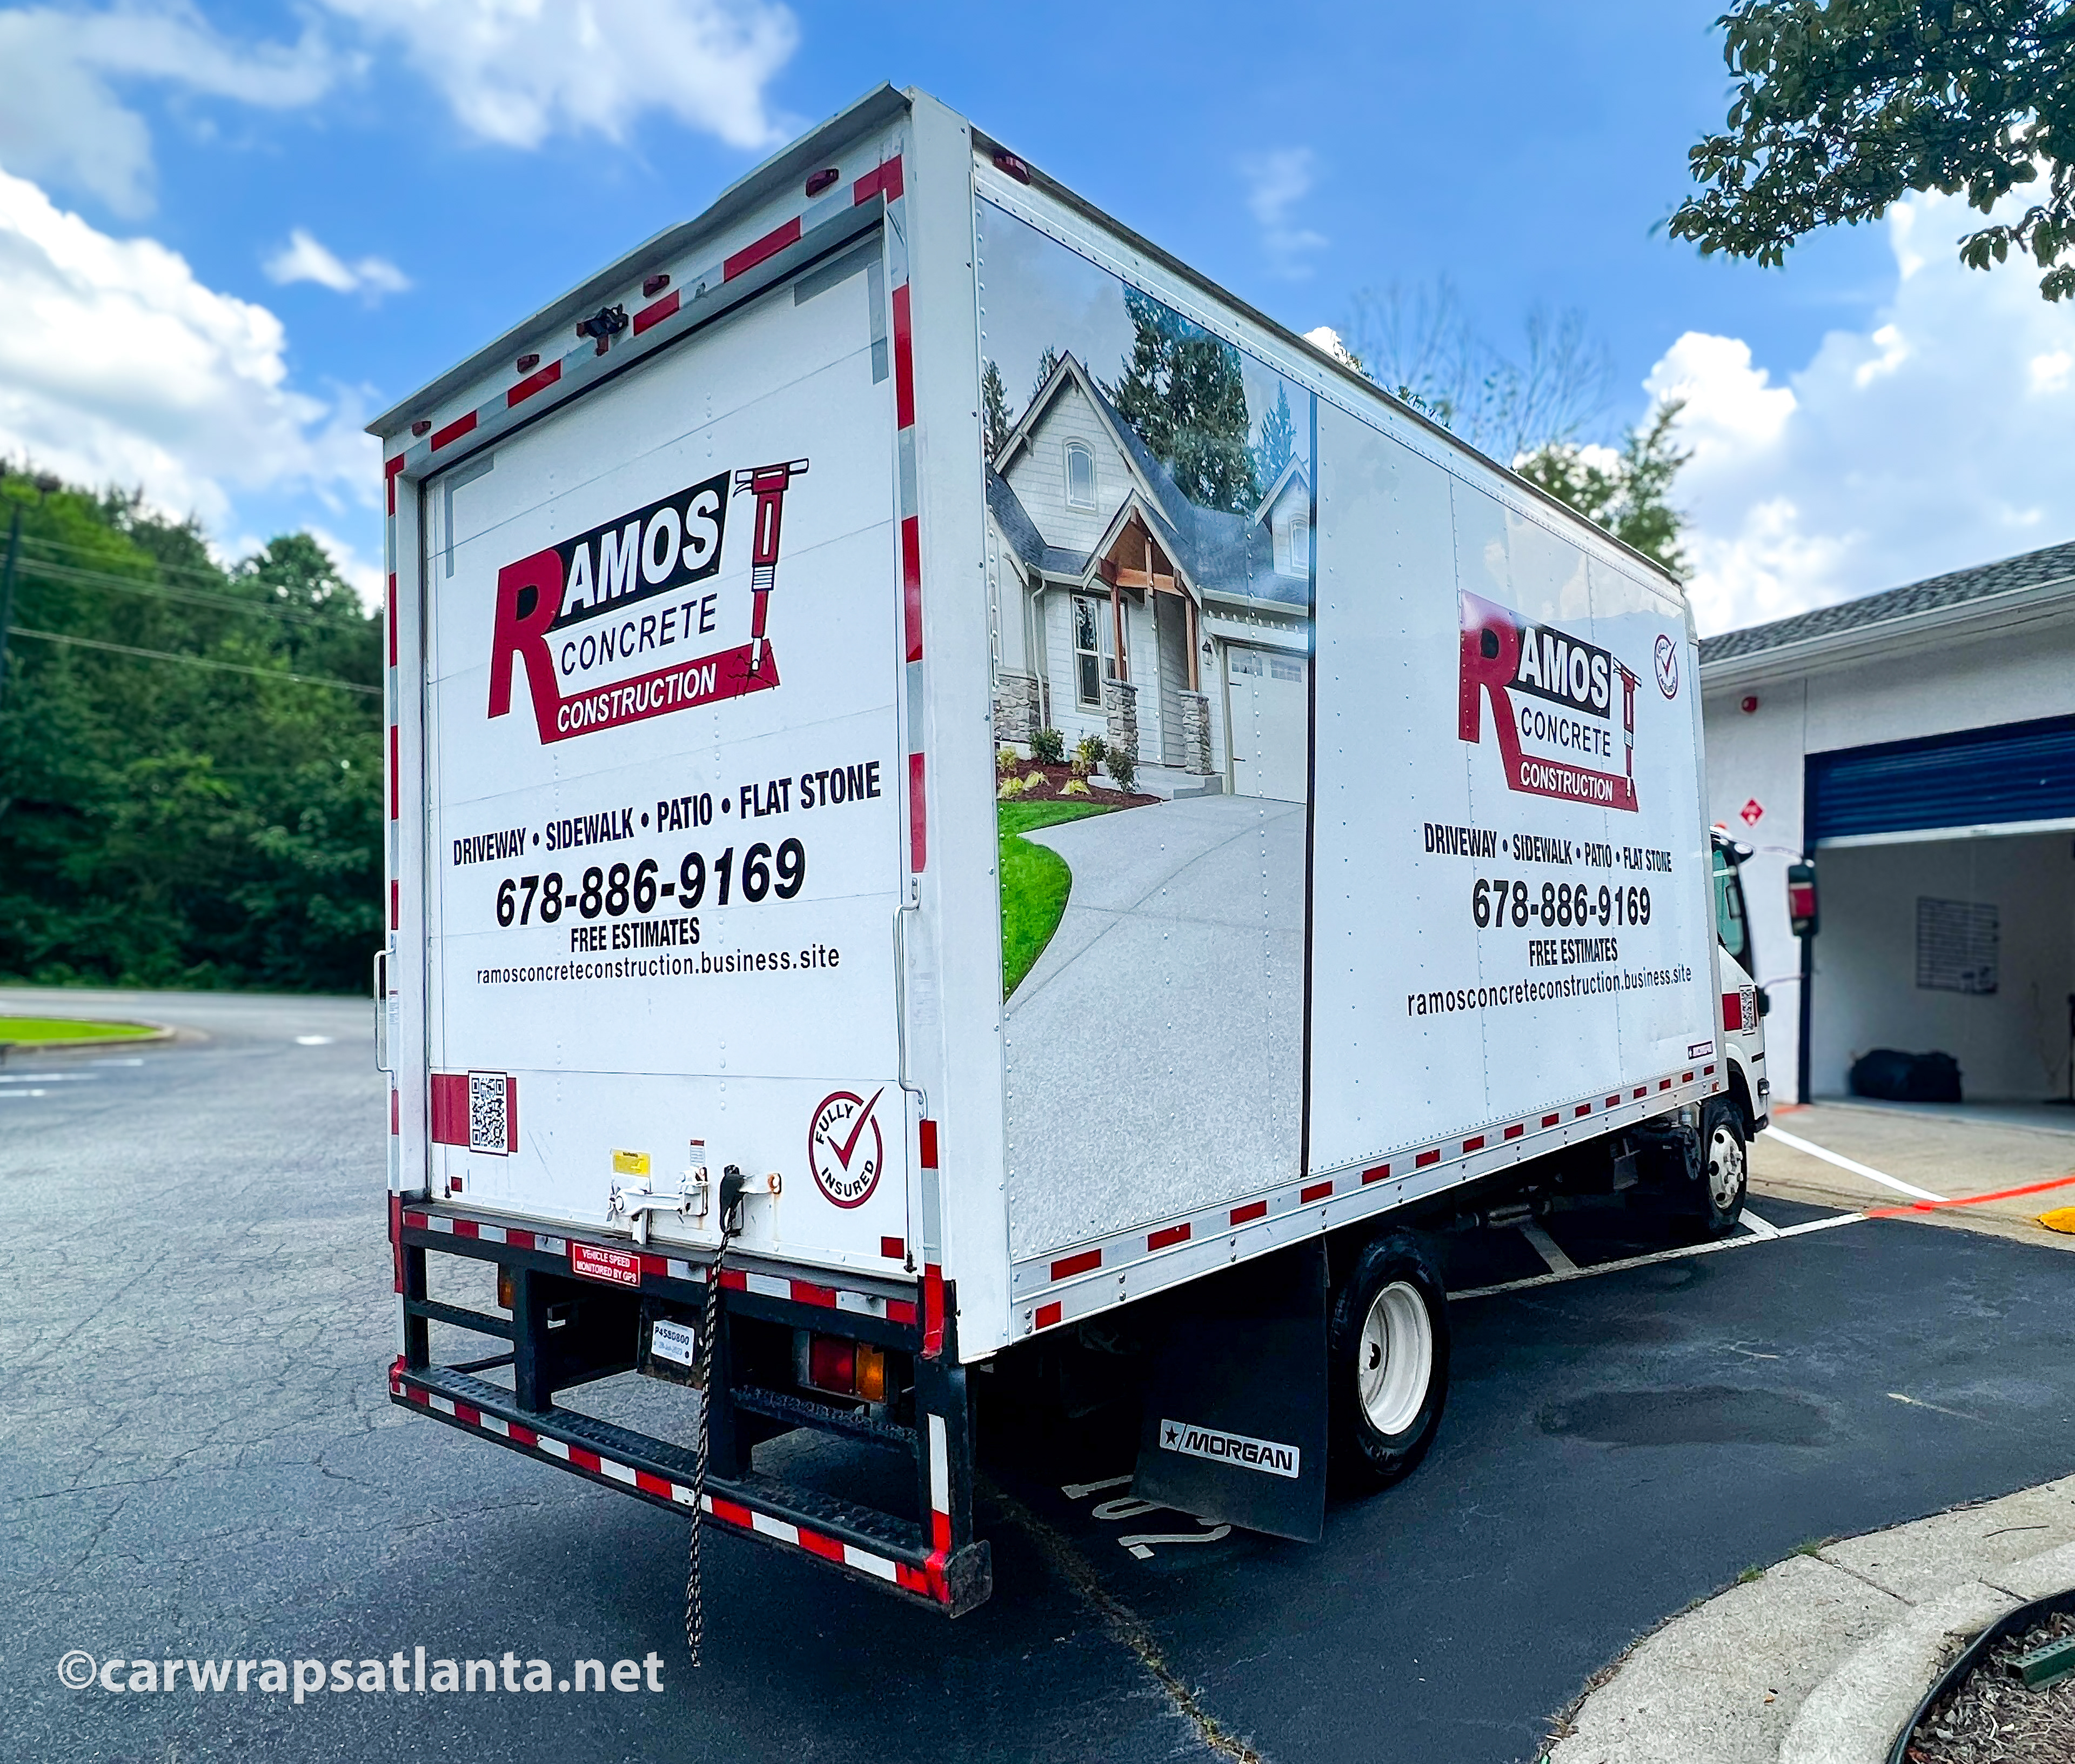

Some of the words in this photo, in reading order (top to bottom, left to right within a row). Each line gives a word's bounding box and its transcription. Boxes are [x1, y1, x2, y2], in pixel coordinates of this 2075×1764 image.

[488, 490, 720, 744] RAMOS
[561, 593, 718, 676] CONCRETE
[557, 663, 717, 732] CONSTRUCTION
[1458, 589, 1609, 790] RAMOS
[1521, 707, 1611, 757] CONCRETE
[1520, 761, 1613, 801] CONSTRUCTION
[453, 827, 526, 866] DRIVEWAY
[546, 807, 633, 851] SIDEWALK
[657, 793, 712, 833] PATIO
[740, 777, 792, 819] FLAT
[800, 761, 881, 810] STONE
[1424, 823, 1497, 858] DRIVEWAY
[1513, 833, 1572, 865] SIDEWALK
[1585, 842, 1612, 868] PATIO
[1623, 846, 1643, 871] FLAT
[1646, 850, 1672, 872] STONE
[496, 837, 806, 927] 678-886-9169
[1472, 879, 1650, 927] 678-886-9169
[571, 925, 607, 953] FREE
[612, 917, 700, 950] ESTIMATES
[1529, 939, 1557, 967] FREE
[1561, 937, 1617, 965] ESTIMATES
[477, 943, 840, 985] ramosconcreteconstruction.business.site
[1408, 965, 1692, 1016] ramosconcreteconstruction.business.site
[815, 1103, 854, 1145] FULLY
[821, 1159, 874, 1197] INSURED
[576, 1260, 613, 1277] MONITORED
[613, 1268, 622, 1279] BY
[622, 1271, 637, 1283] GPS
[582, 1248, 608, 1262] VEHICLE
[609, 1254, 630, 1267] SPEED
[1184, 1431, 1293, 1471] MORGAN
